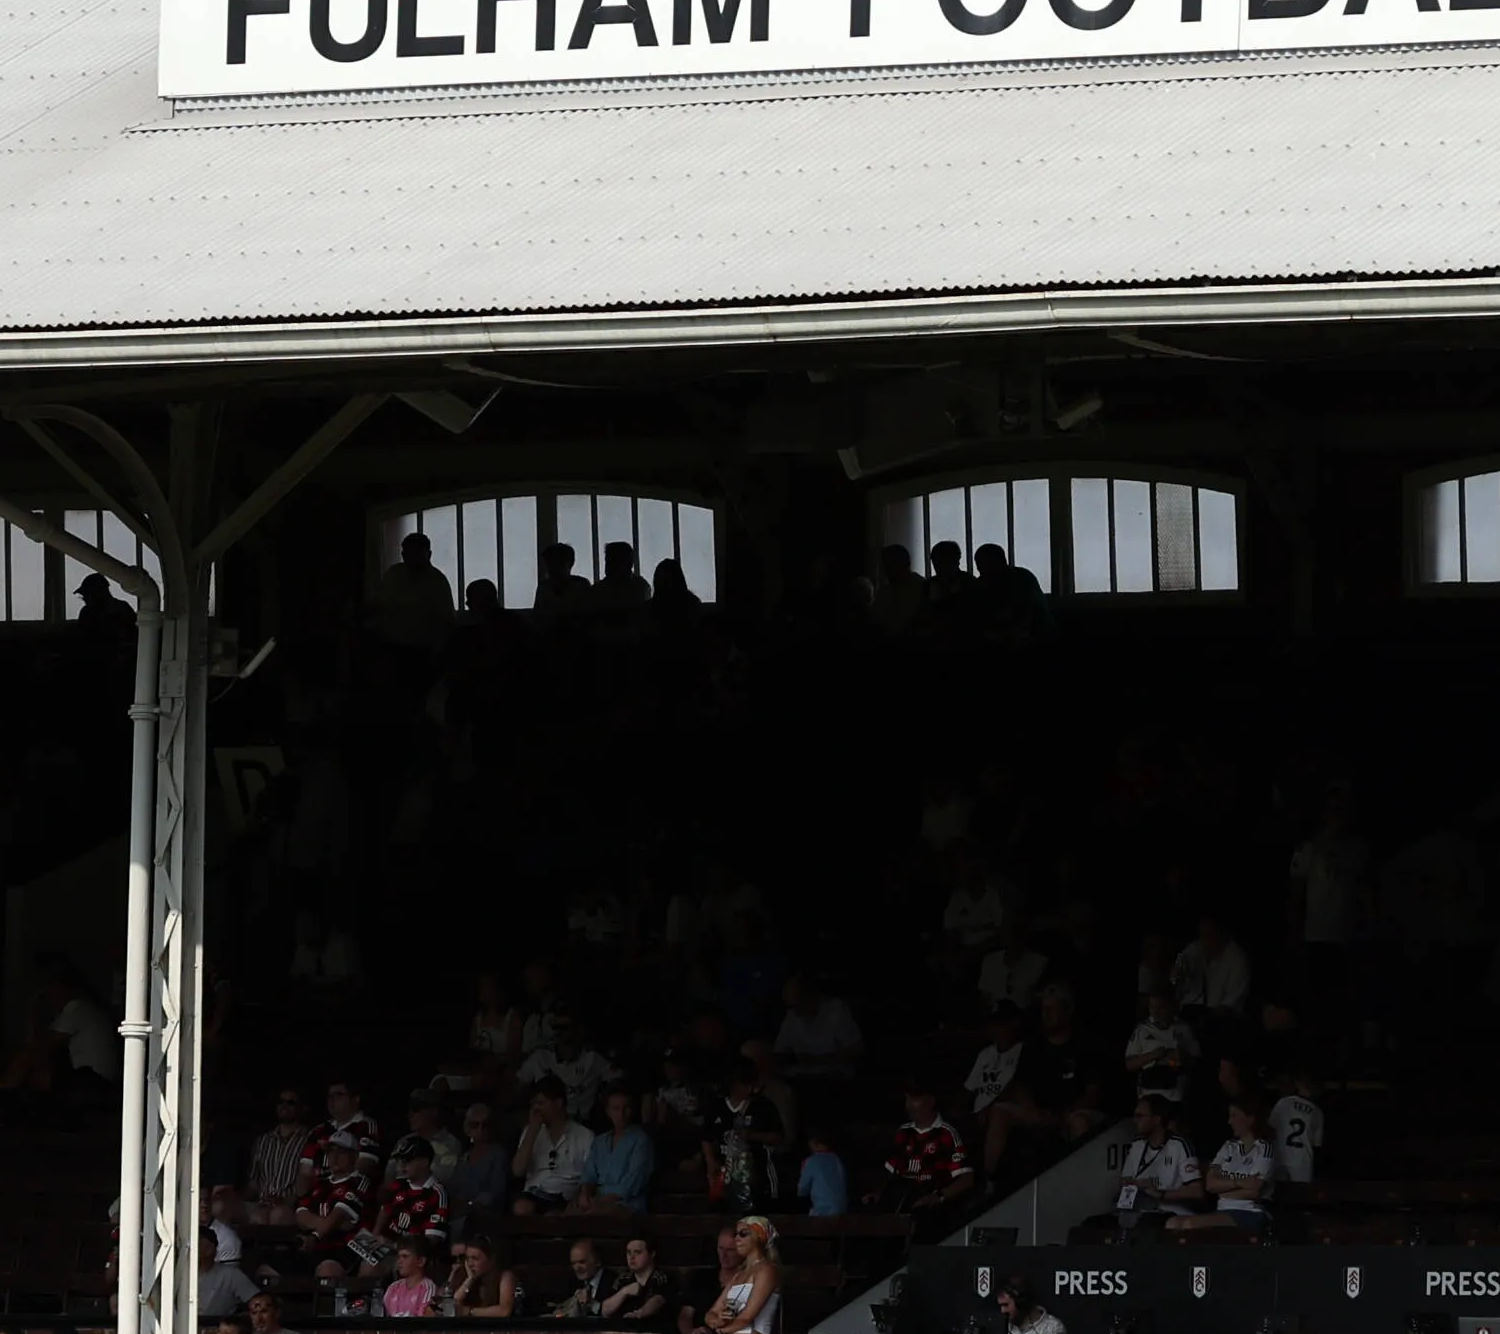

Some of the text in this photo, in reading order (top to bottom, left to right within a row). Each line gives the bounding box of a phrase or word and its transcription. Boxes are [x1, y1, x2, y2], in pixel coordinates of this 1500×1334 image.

[1285, 1117, 1306, 1148] 2
[1055, 1270, 1128, 1295] PRESS
[1426, 1271, 1500, 1296] PRESS
